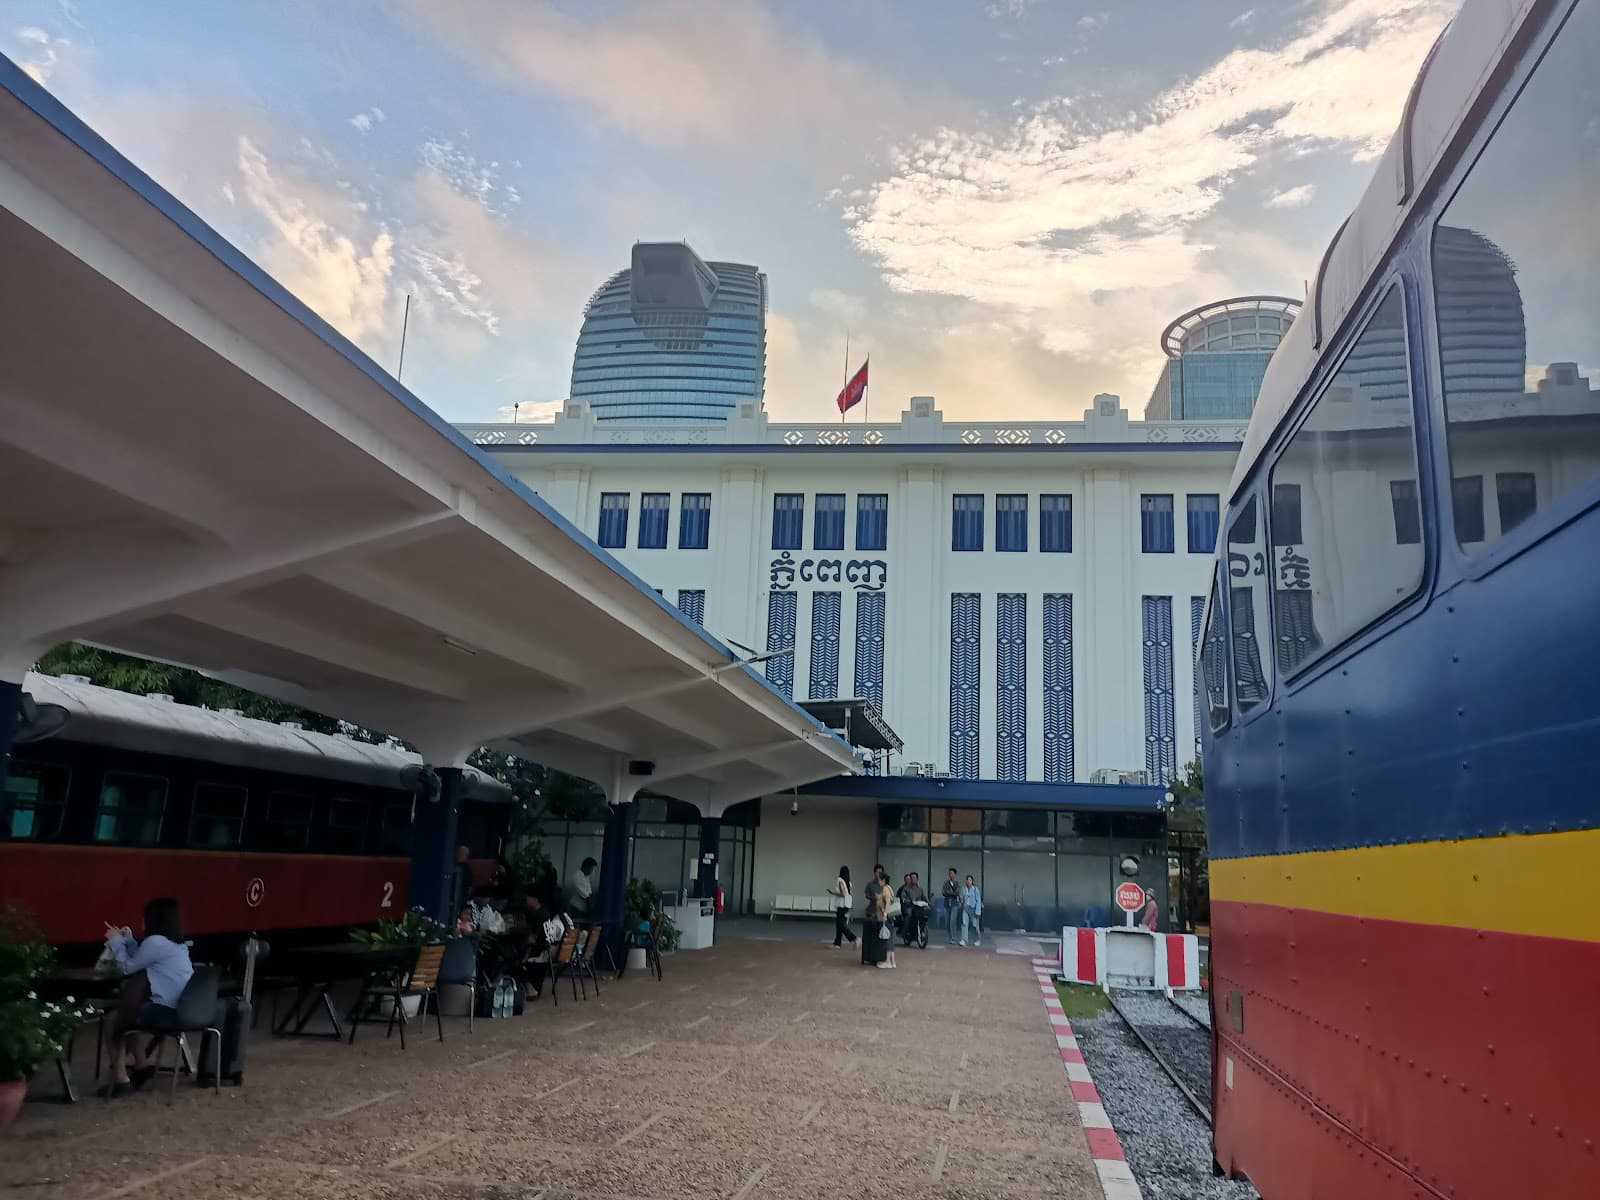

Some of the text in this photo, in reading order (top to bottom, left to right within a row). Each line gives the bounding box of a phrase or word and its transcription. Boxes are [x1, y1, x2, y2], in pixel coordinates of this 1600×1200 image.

[770, 551, 887, 590] ភ្នំពេញ
[381, 881, 394, 907] 2
